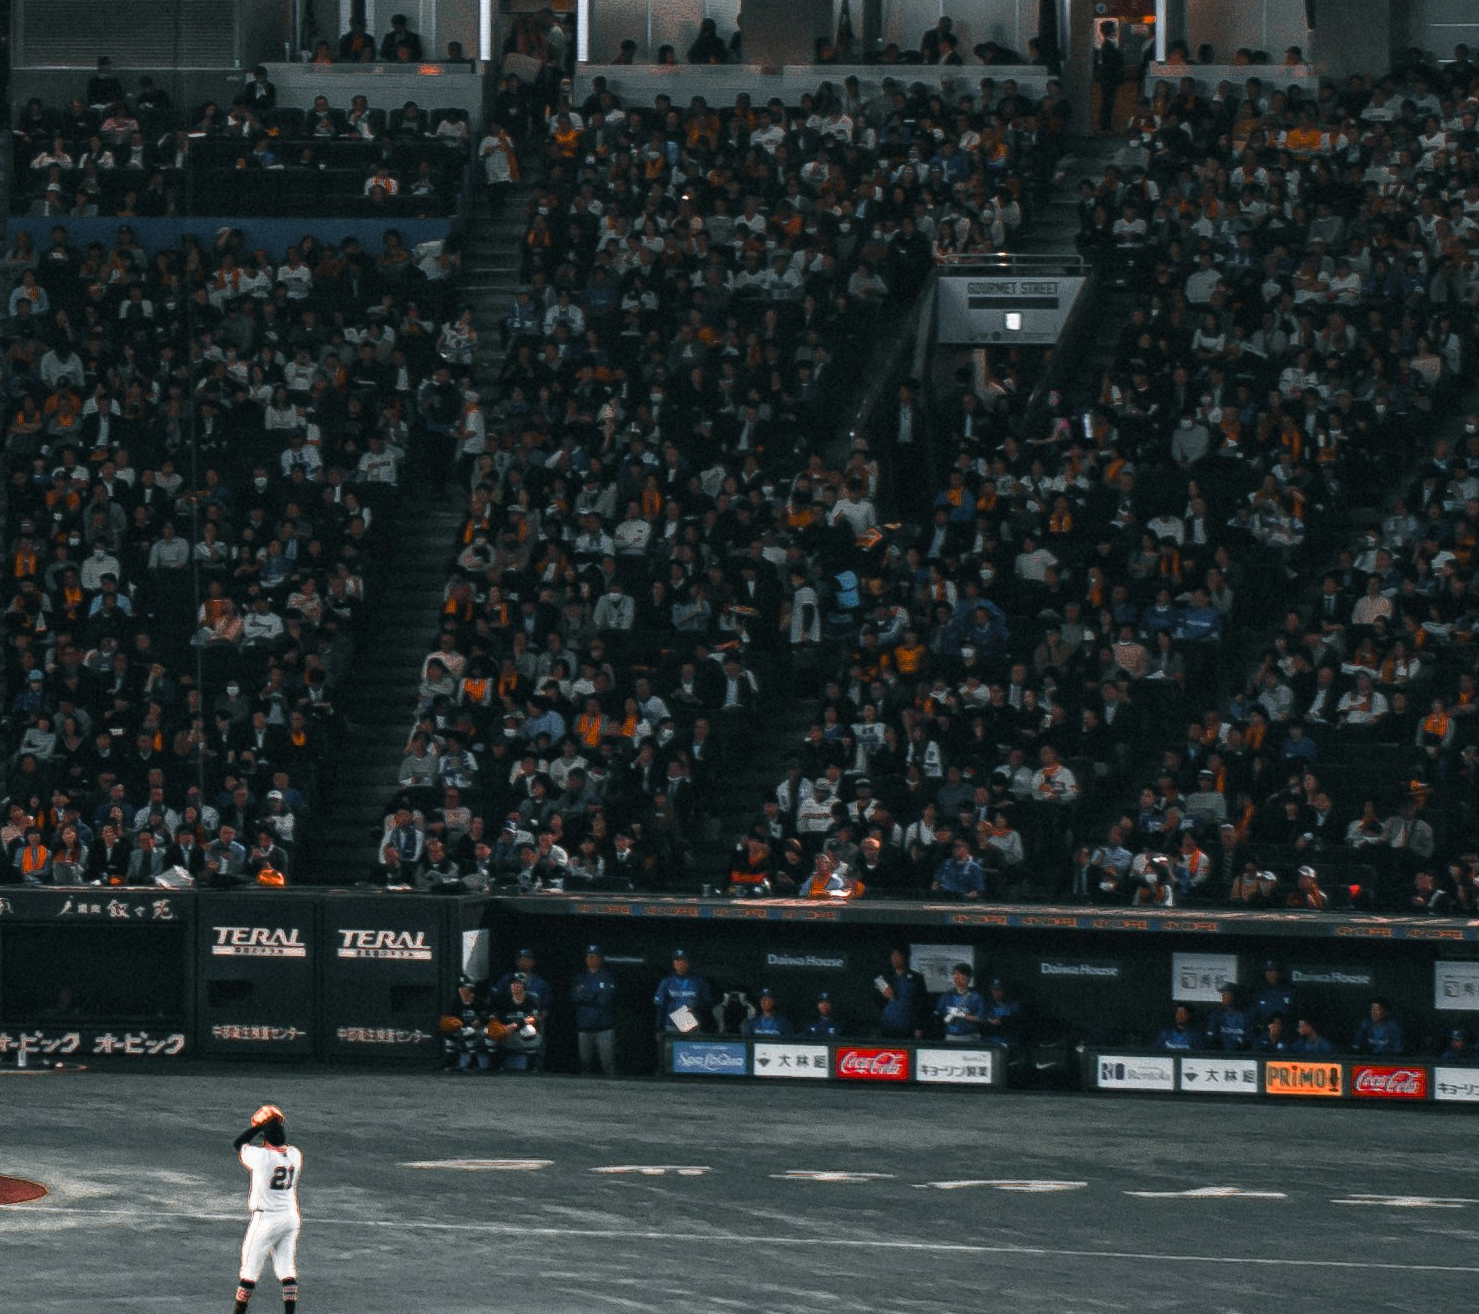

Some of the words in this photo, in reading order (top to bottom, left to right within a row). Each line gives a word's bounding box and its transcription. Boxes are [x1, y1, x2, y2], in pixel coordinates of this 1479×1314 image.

[967, 281, 1017, 296] GOURMET
[1020, 281, 1060, 296] STREET
[212, 925, 308, 947] TERAL
[336, 928, 433, 950] TERAL
[766, 953, 805, 968] Daiwa
[806, 953, 844, 968] House
[1040, 961, 1079, 977] Daiwa
[1079, 961, 1119, 977] House
[1291, 970, 1330, 985] Daiwa
[1331, 970, 1371, 985] House
[91, 1031, 187, 1055] オービック
[777, 1054, 828, 1069] 大林組
[1204, 1069, 1256, 1084] 大林組
[269, 1164, 294, 1190] 21
